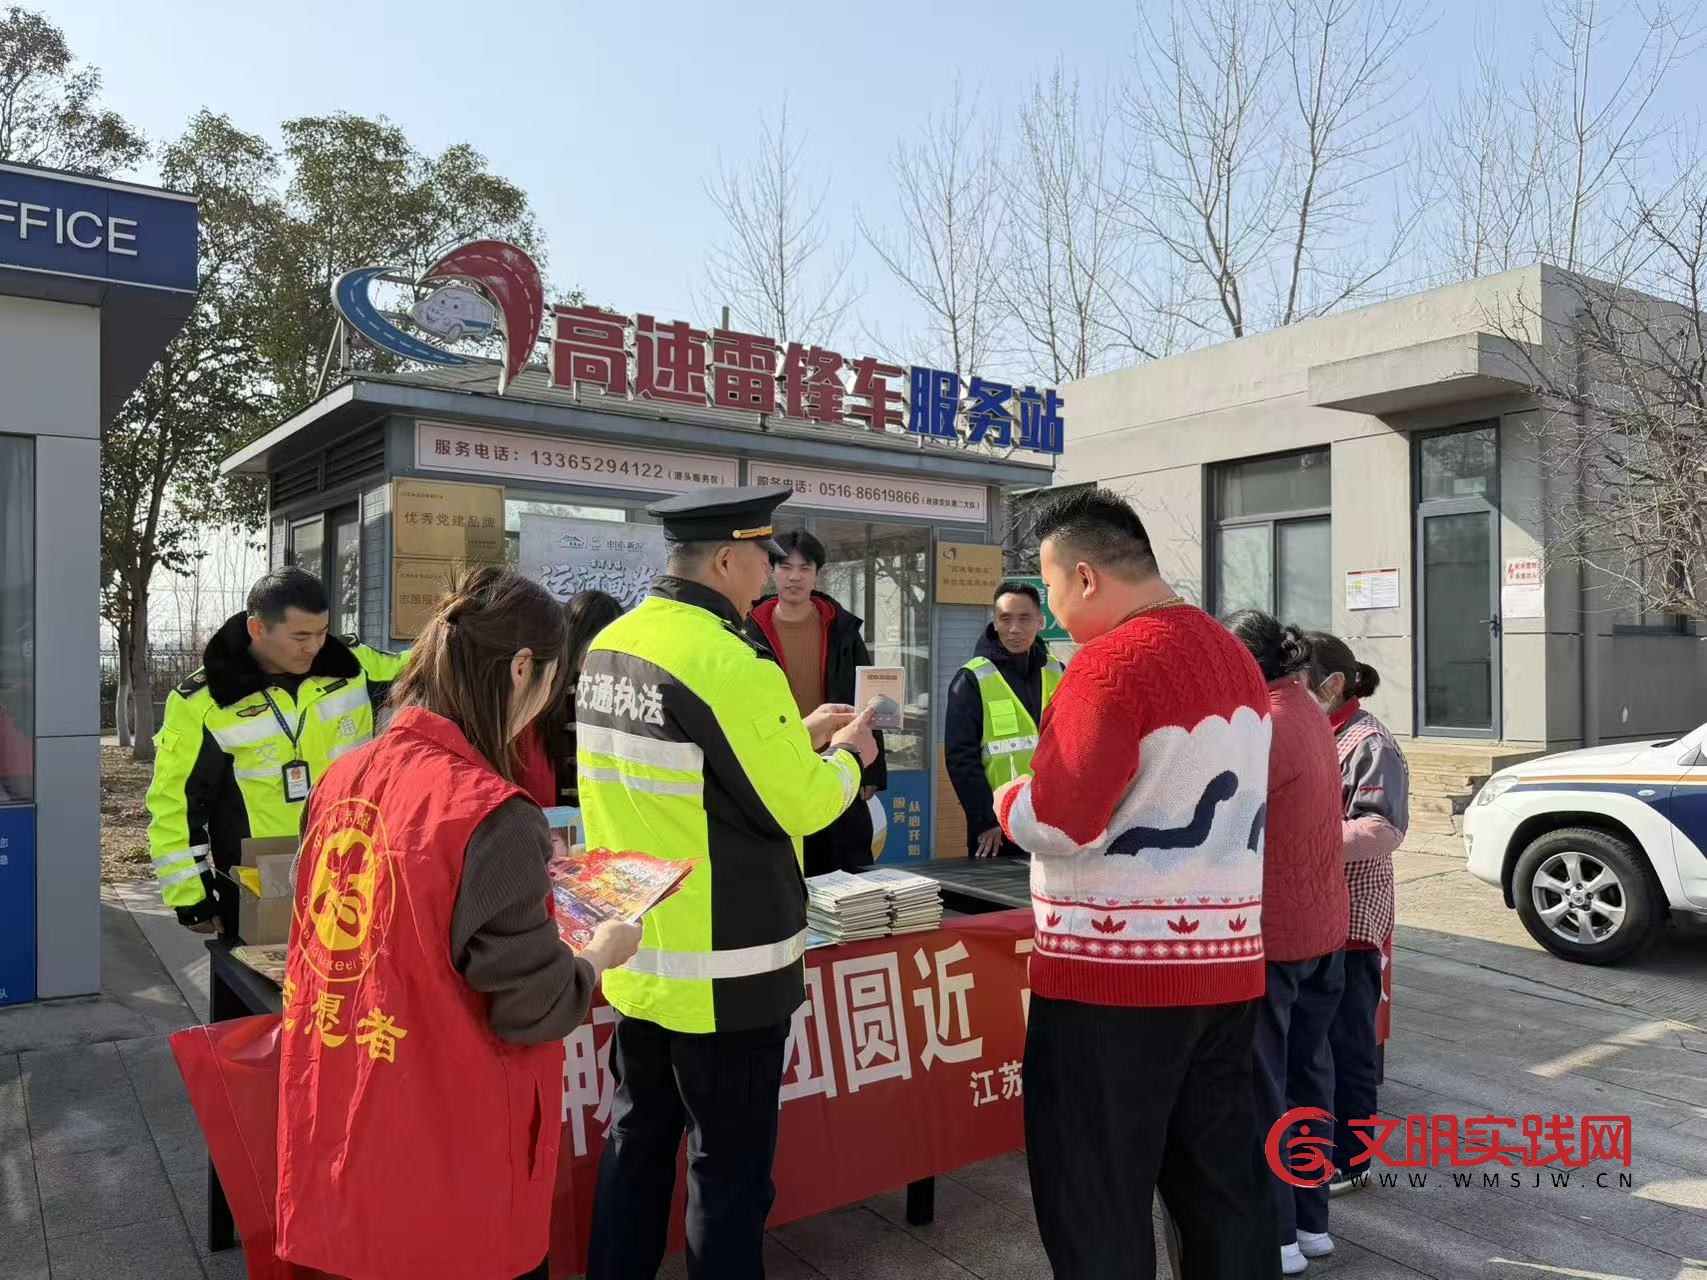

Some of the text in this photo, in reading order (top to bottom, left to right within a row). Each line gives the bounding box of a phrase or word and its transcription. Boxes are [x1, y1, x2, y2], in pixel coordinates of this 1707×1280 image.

[546, 303, 1065, 455] 高速雷锋车服务站
[404, 511, 496, 529] 优秀党建品牌
